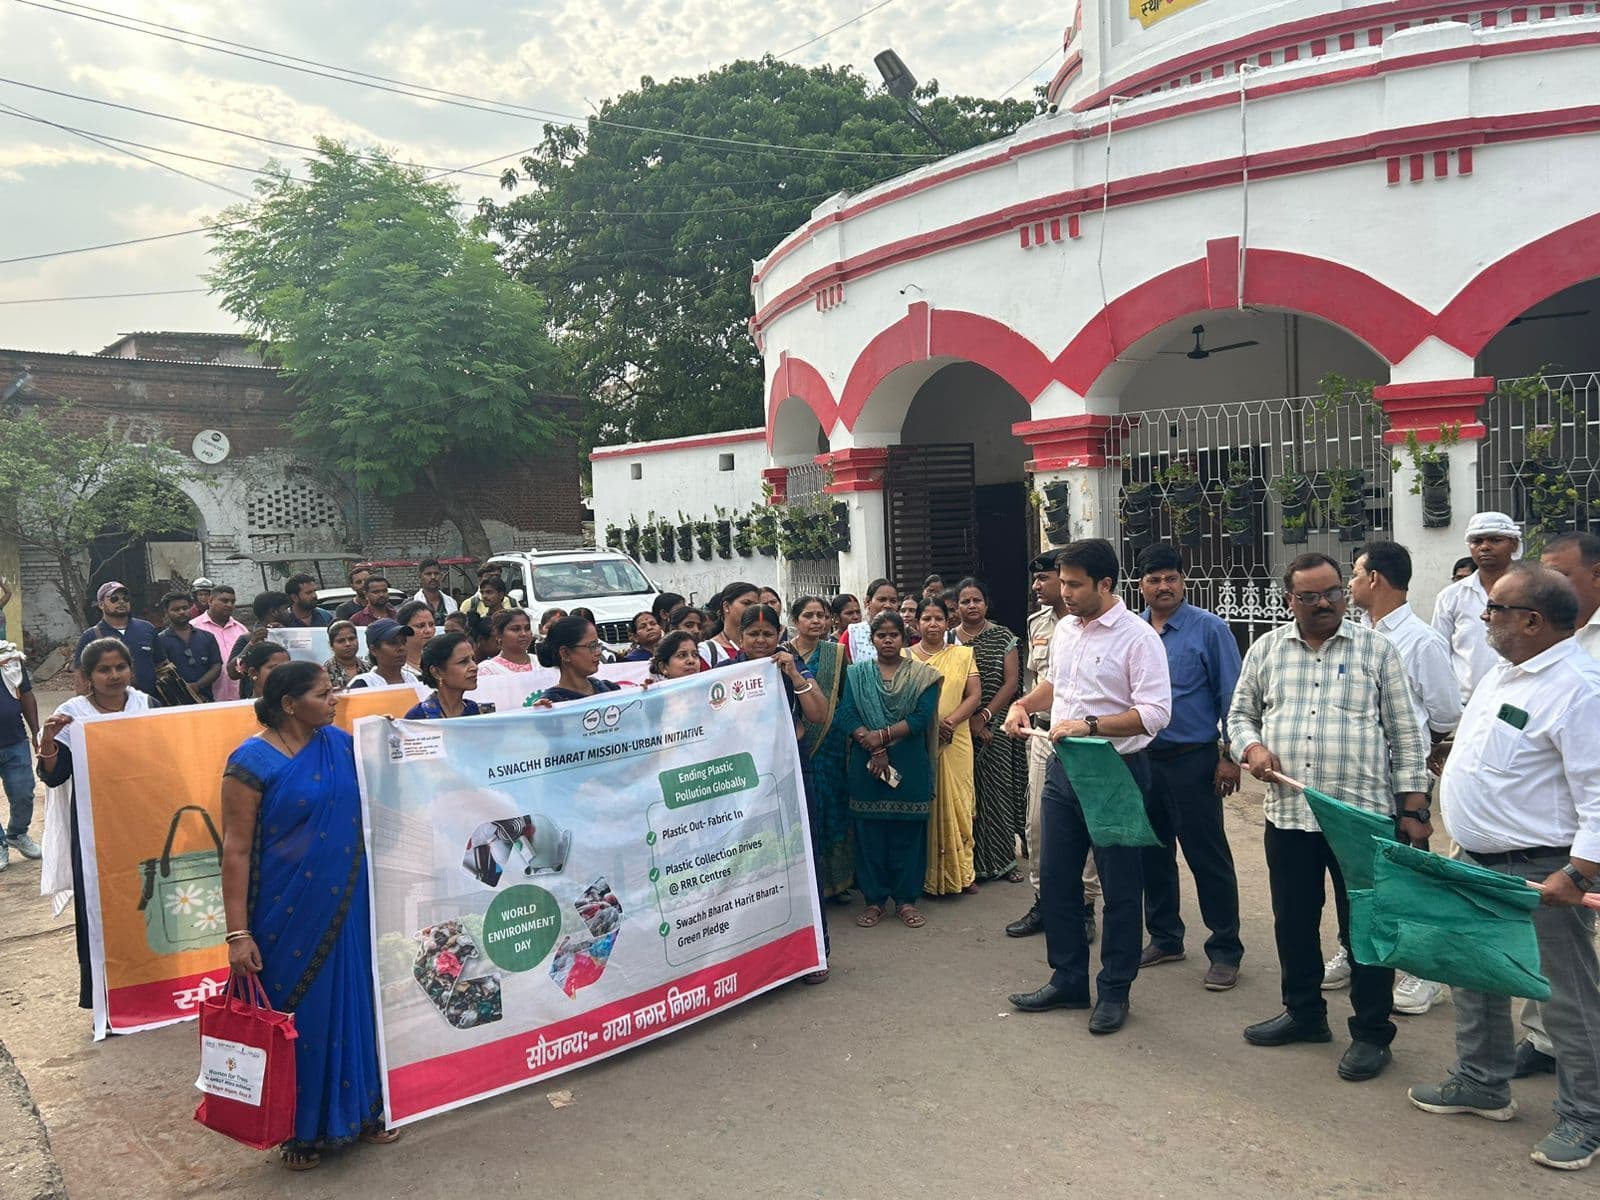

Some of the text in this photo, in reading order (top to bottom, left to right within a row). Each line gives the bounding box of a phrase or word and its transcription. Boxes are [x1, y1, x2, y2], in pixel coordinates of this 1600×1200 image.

[745, 677, 763, 691] LiFE
[488, 725, 705, 779] A SWACHH BHARAT MISSION-URBAN INITIATIVE
[678, 760, 734, 784] Ending Plastic
[675, 776, 747, 802] Pollution Globally
[662, 809, 744, 840] Plastic Out- Fabric In
[665, 839, 763, 876] Plastic Collection Drives
[669, 867, 732, 896] @ RRR Centres
[501, 903, 537, 921] WORLD
[675, 911, 707, 930] Swachh
[708, 900, 734, 919] Bharat
[734, 893, 755, 909] Harit
[755, 884, 780, 901] Bharat
[487, 915, 556, 943] ENVIRONMENT
[677, 919, 730, 948] Green Pledge
[514, 938, 532, 953] DAY
[602, 1013, 632, 1043] गया
[632, 1000, 668, 1030] नगर
[667, 985, 711, 1019] निगम,
[713, 972, 738, 999] गया
